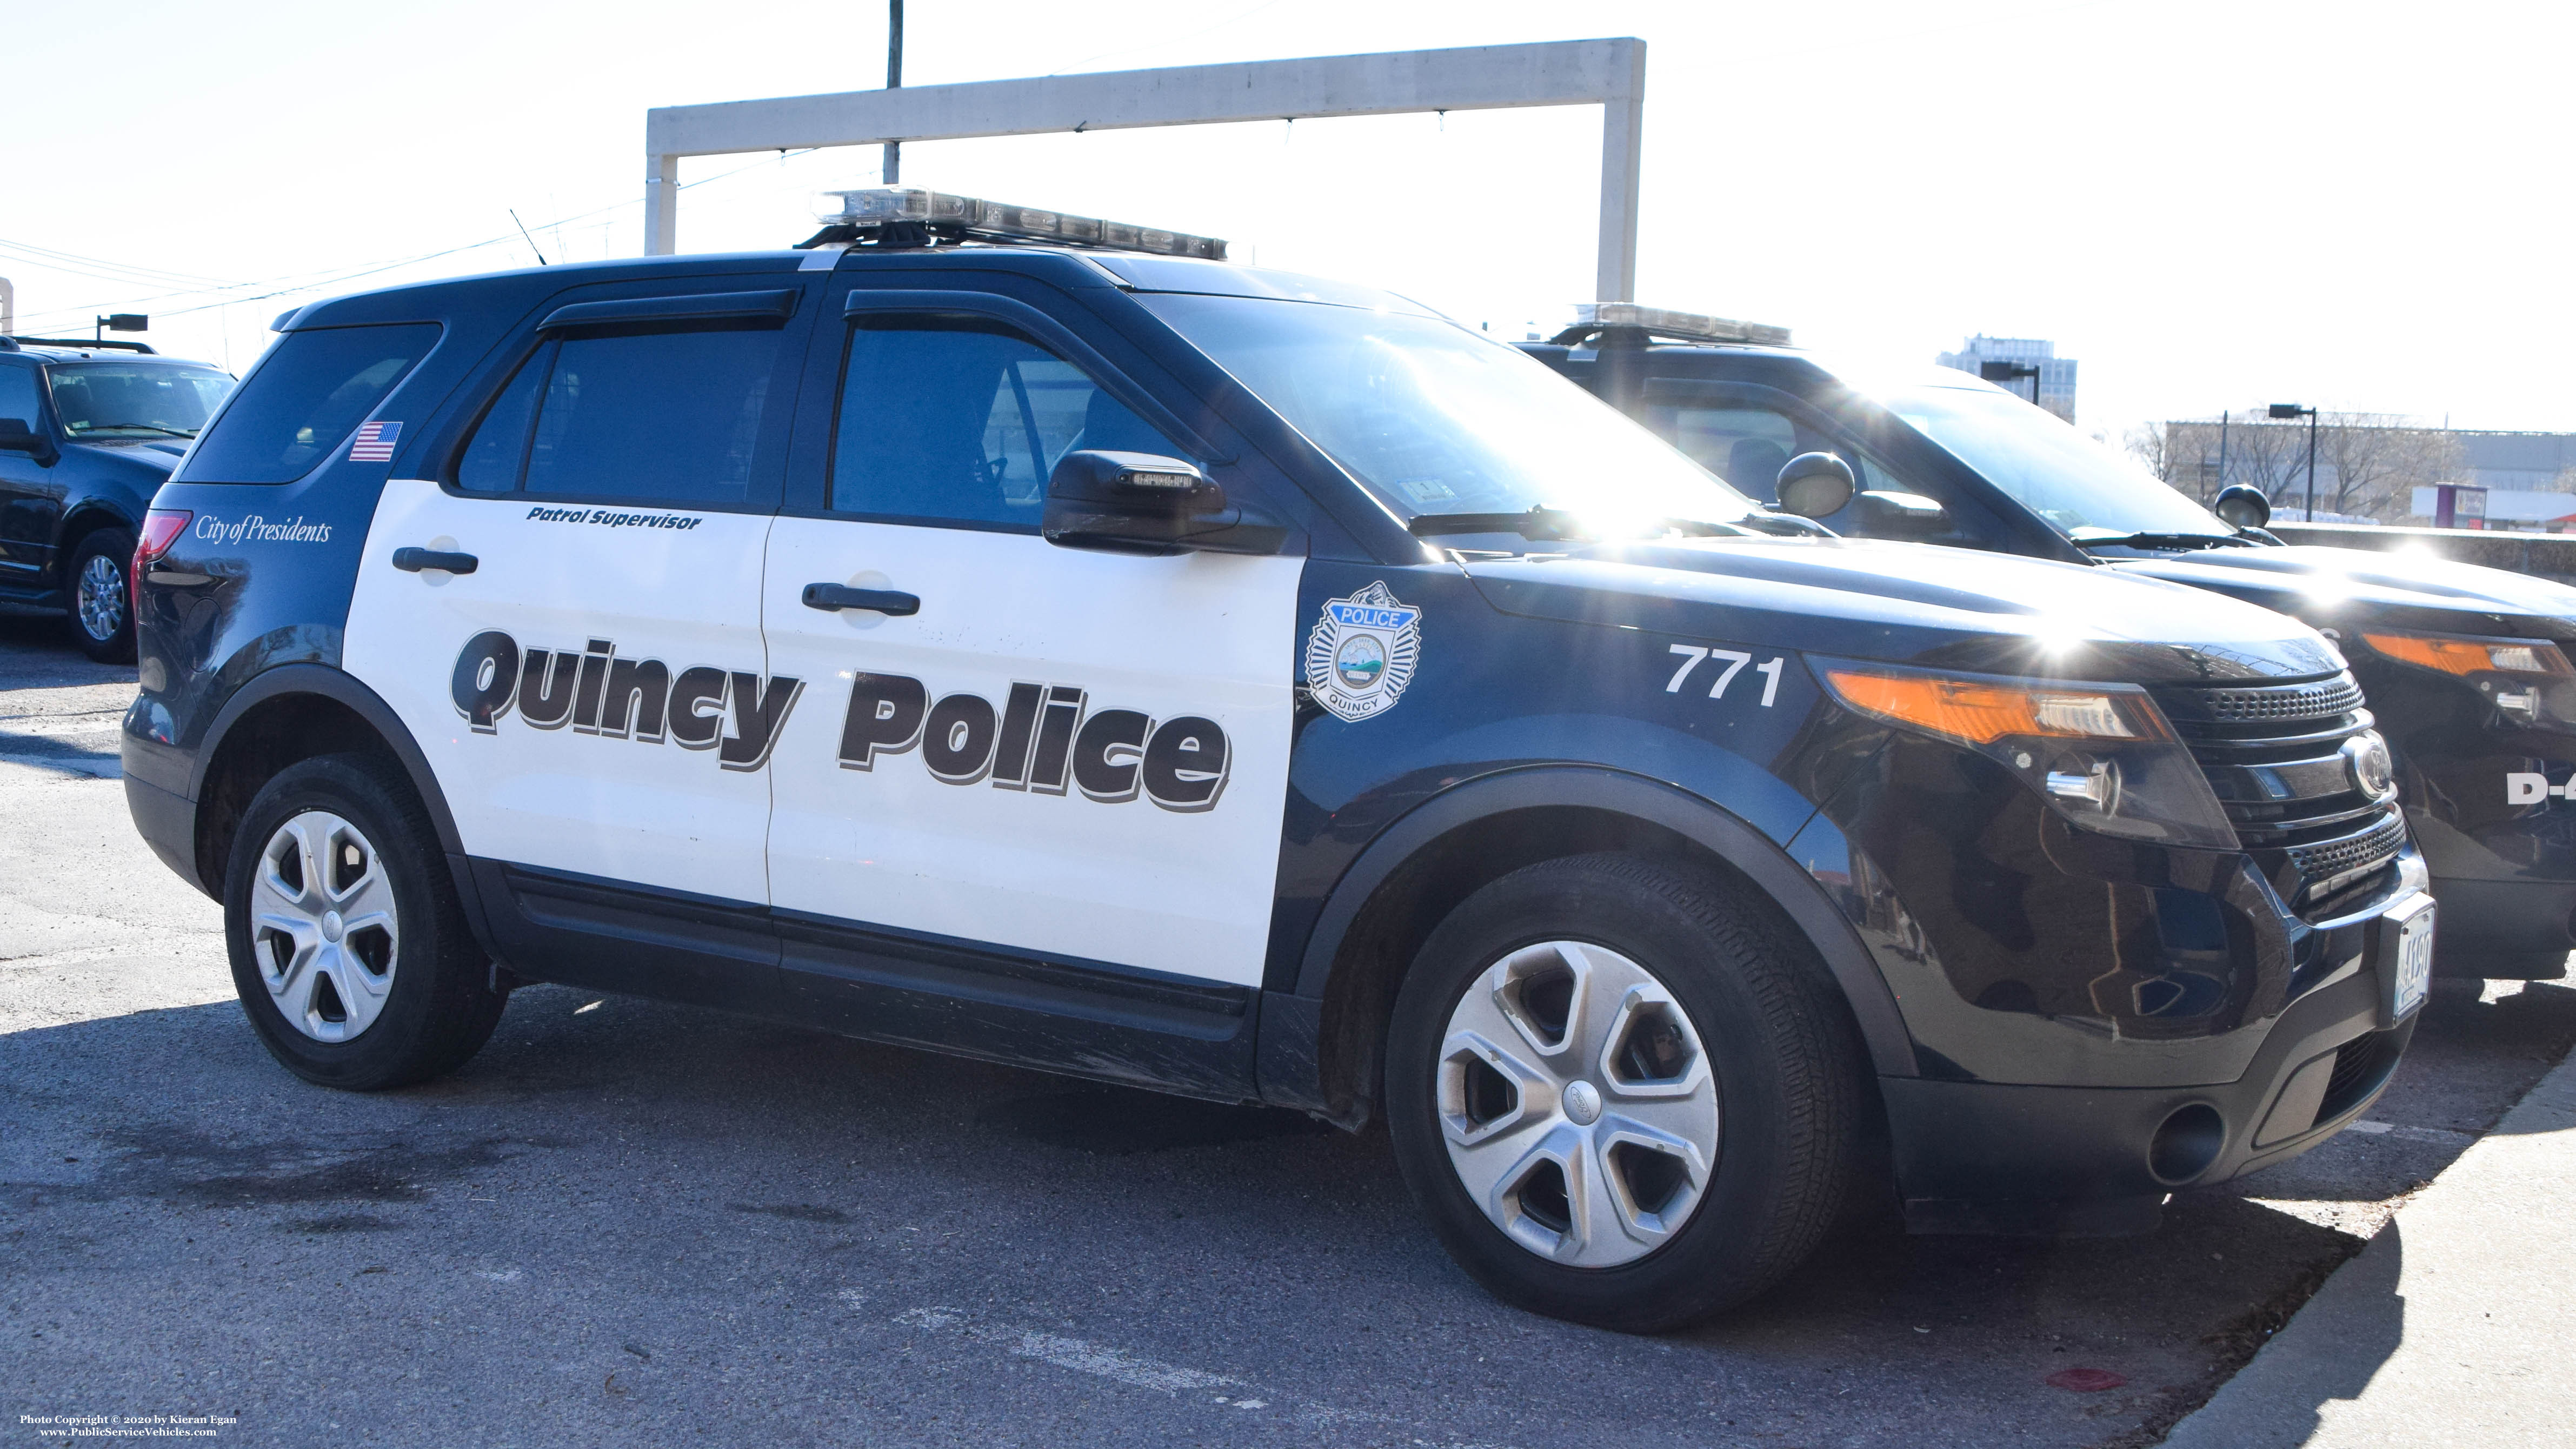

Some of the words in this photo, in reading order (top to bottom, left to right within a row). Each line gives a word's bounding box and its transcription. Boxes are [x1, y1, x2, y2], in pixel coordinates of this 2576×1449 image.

[196, 515, 229, 544] City
[229, 515, 252, 545] of
[246, 516, 332, 542] Presidents
[526, 507, 591, 523] Patrol
[589, 510, 703, 530] Supervisor
[1341, 607, 1400, 627] POLICE
[1666, 644, 1783, 707] 771
[1329, 694, 1377, 711] QUINCY
[449, 627, 807, 773] Quincy
[836, 668, 1233, 813] Police
